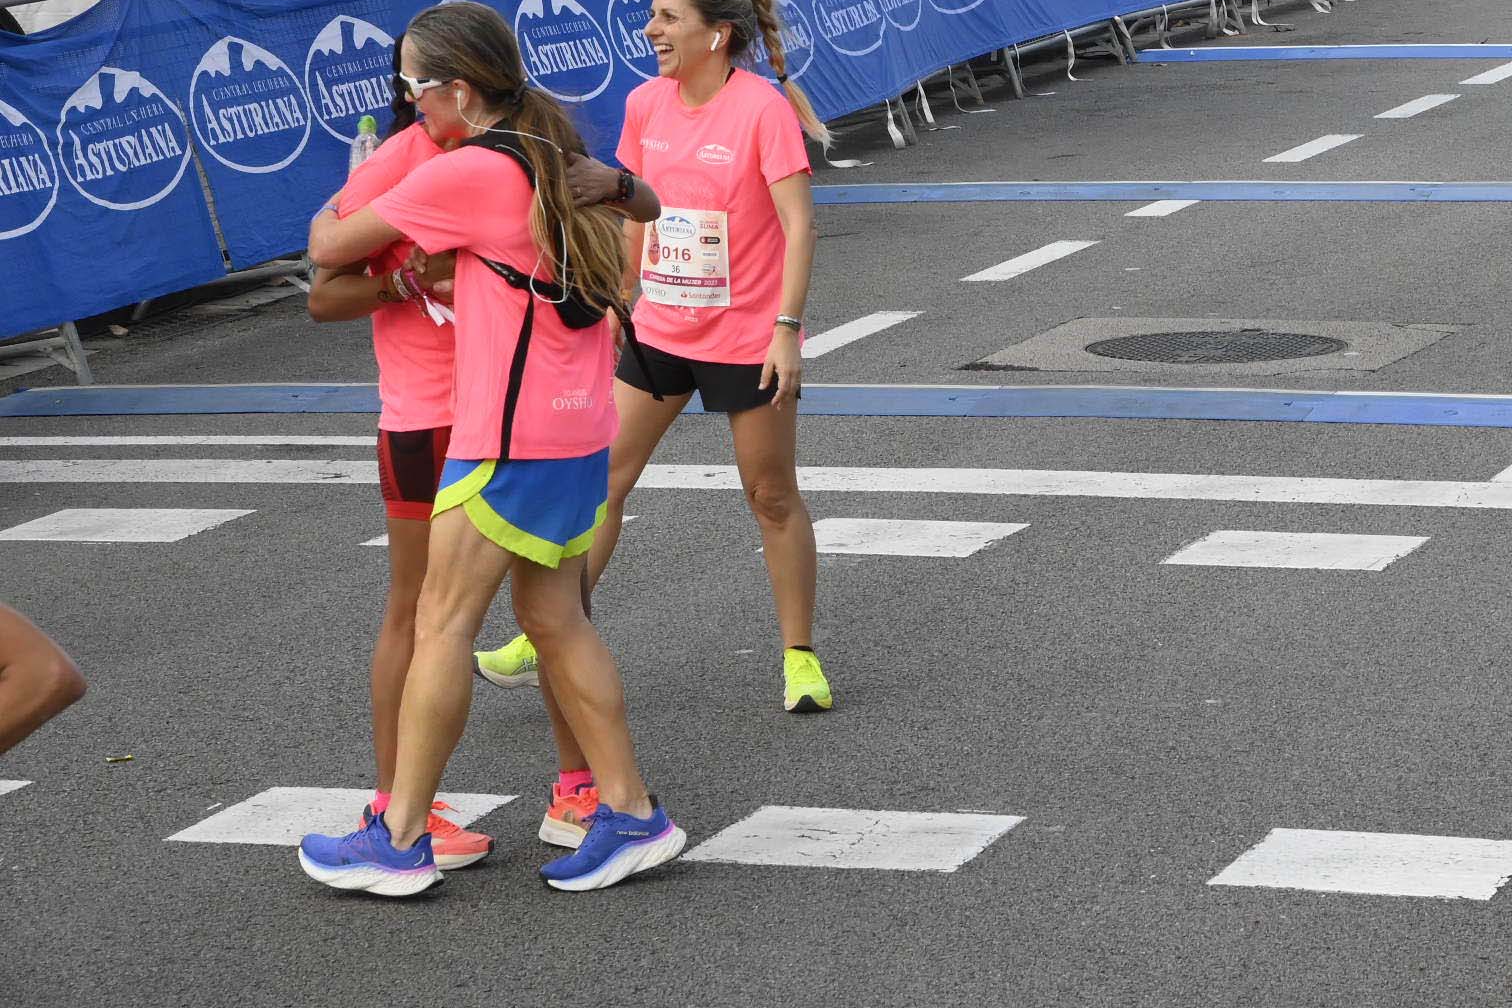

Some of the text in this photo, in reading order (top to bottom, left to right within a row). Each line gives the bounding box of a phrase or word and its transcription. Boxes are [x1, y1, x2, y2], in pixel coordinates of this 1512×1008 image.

[524, 31, 608, 77] ASTURIANA
[326, 59, 362, 79] CENTRAL
[213, 83, 252, 102] CENTRAL
[81, 115, 124, 136] CENTRAL
[202, 93, 305, 146] ASTURIANA
[671, 265, 681, 273] 36
[552, 396, 593, 410] OYSHO
